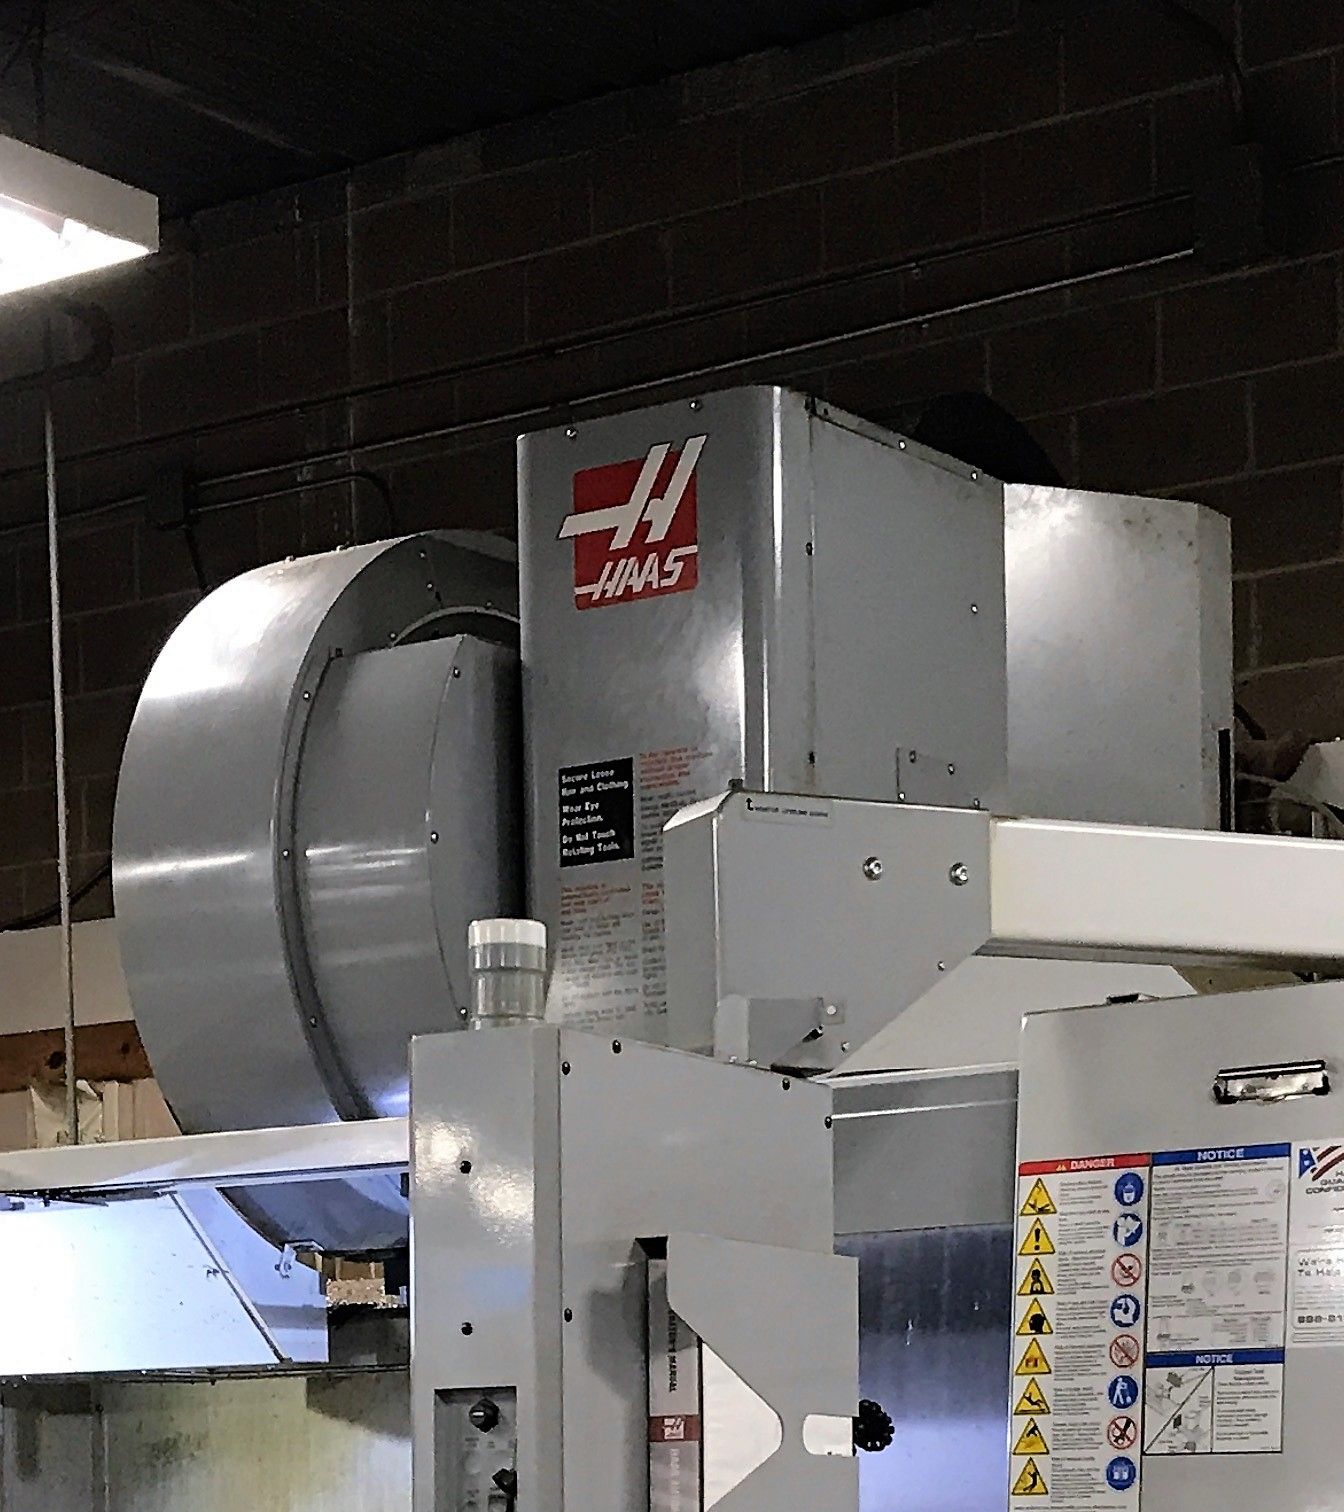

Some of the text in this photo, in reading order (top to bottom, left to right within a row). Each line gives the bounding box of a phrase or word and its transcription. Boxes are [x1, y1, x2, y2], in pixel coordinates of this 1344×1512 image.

[574, 544, 698, 601] HAAS
[1197, 1148, 1245, 1161] NOTICE
[1070, 1158, 1115, 1170] DANGER
[1196, 1354, 1234, 1364] NOTICE
